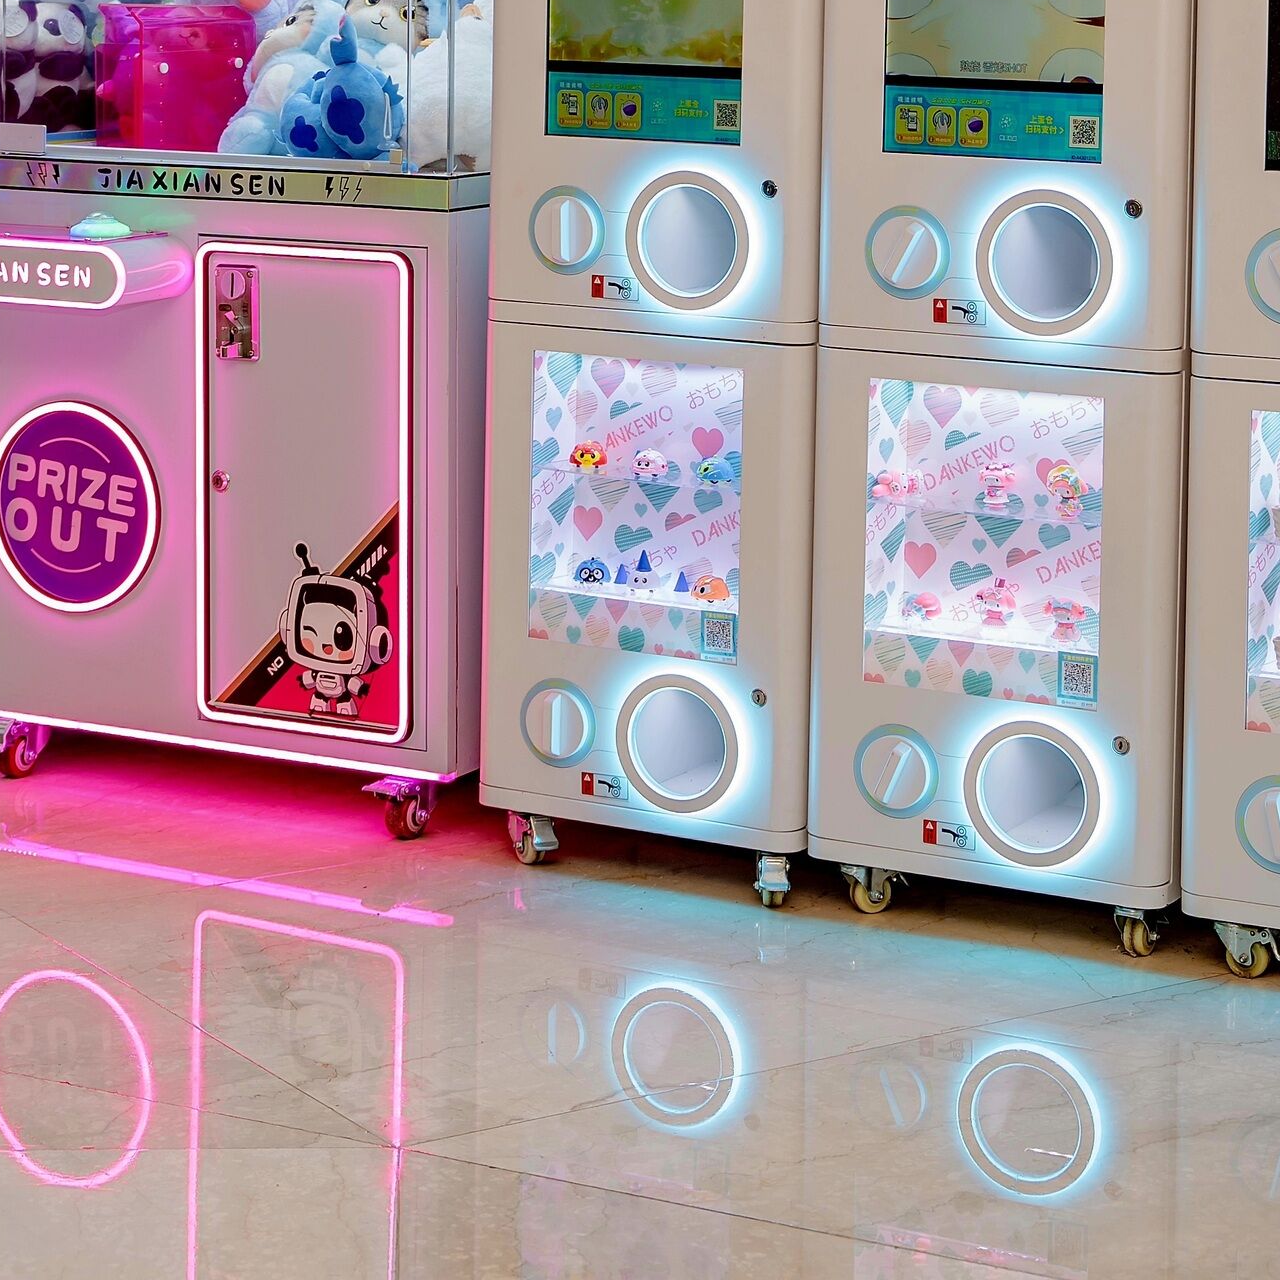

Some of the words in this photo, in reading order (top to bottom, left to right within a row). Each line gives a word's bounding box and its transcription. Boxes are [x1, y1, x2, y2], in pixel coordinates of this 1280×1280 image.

[97, 167, 143, 191] JIA
[151, 169, 222, 193] XIAN
[229, 173, 285, 196] SEN
[37, 262, 91, 289] SEN
[602, 405, 673, 453] ANKEWO
[8, 451, 138, 517] PRIZE
[923, 434, 1016, 492] DANKEWO
[4, 497, 129, 563] OUT
